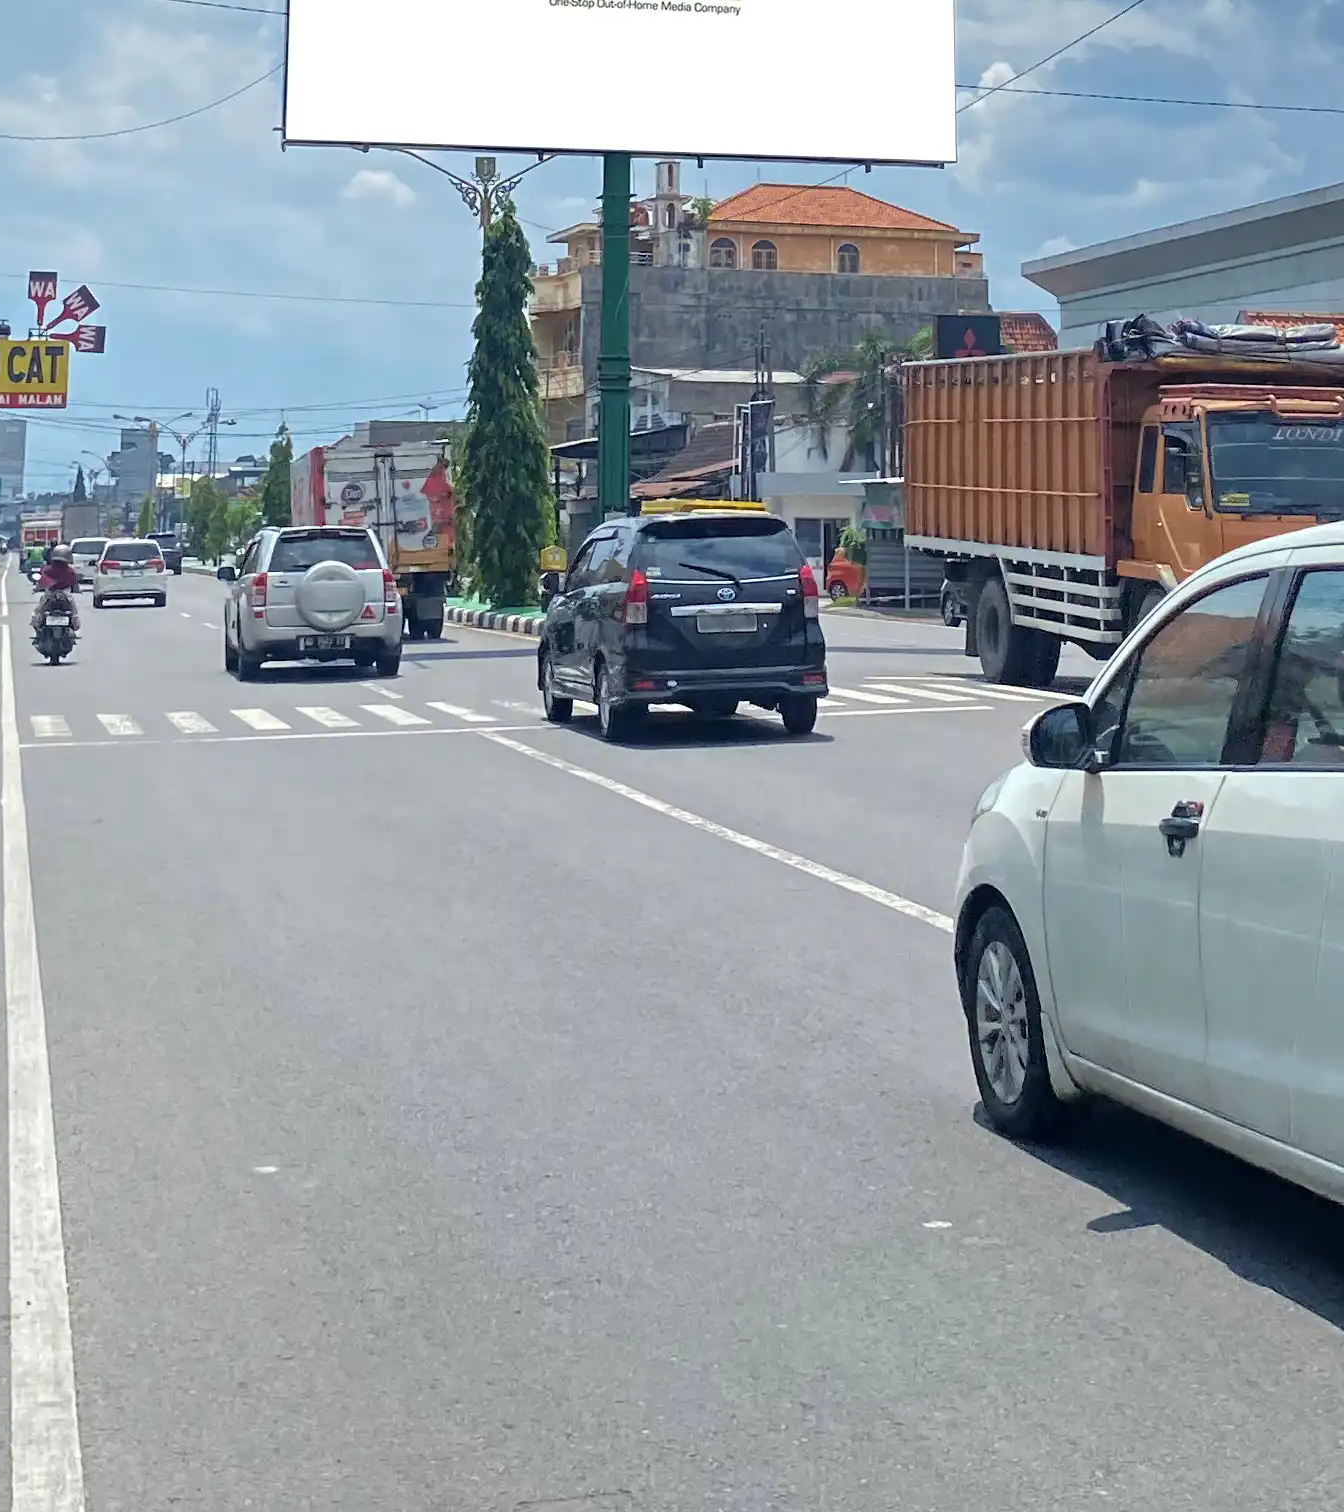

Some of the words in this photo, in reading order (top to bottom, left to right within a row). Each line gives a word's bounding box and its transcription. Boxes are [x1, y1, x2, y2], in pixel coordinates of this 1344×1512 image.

[661, 1, 692, 12] Media
[694, 3, 741, 16] Company
[30, 281, 55, 298] WA
[8, 346, 64, 383] CAT
[18, 394, 63, 405] MALAM
